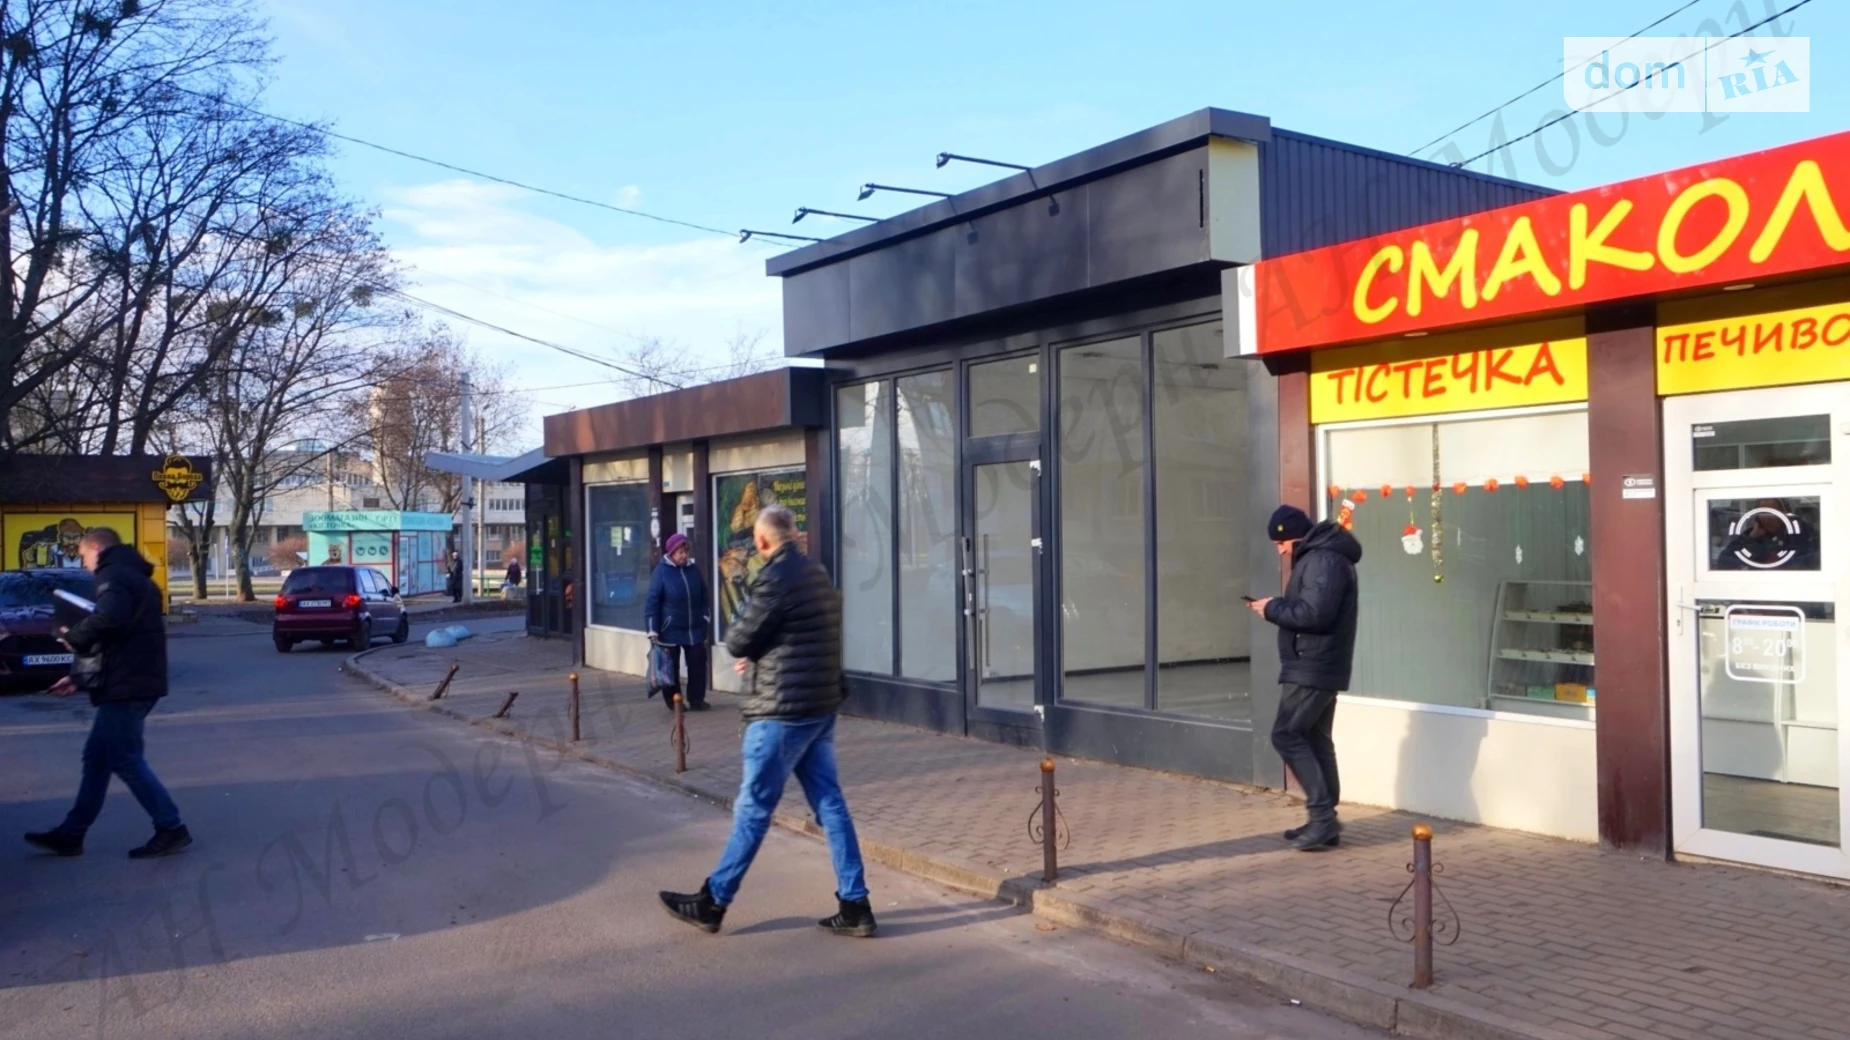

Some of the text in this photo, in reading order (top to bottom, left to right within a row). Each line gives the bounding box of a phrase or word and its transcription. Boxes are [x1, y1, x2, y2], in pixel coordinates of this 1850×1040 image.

[1353, 159, 1850, 325] СМАКОЛ
[1663, 312, 1850, 364] ПЕЧИВО
[1327, 341, 1565, 404] ТІСТЕЧКА
